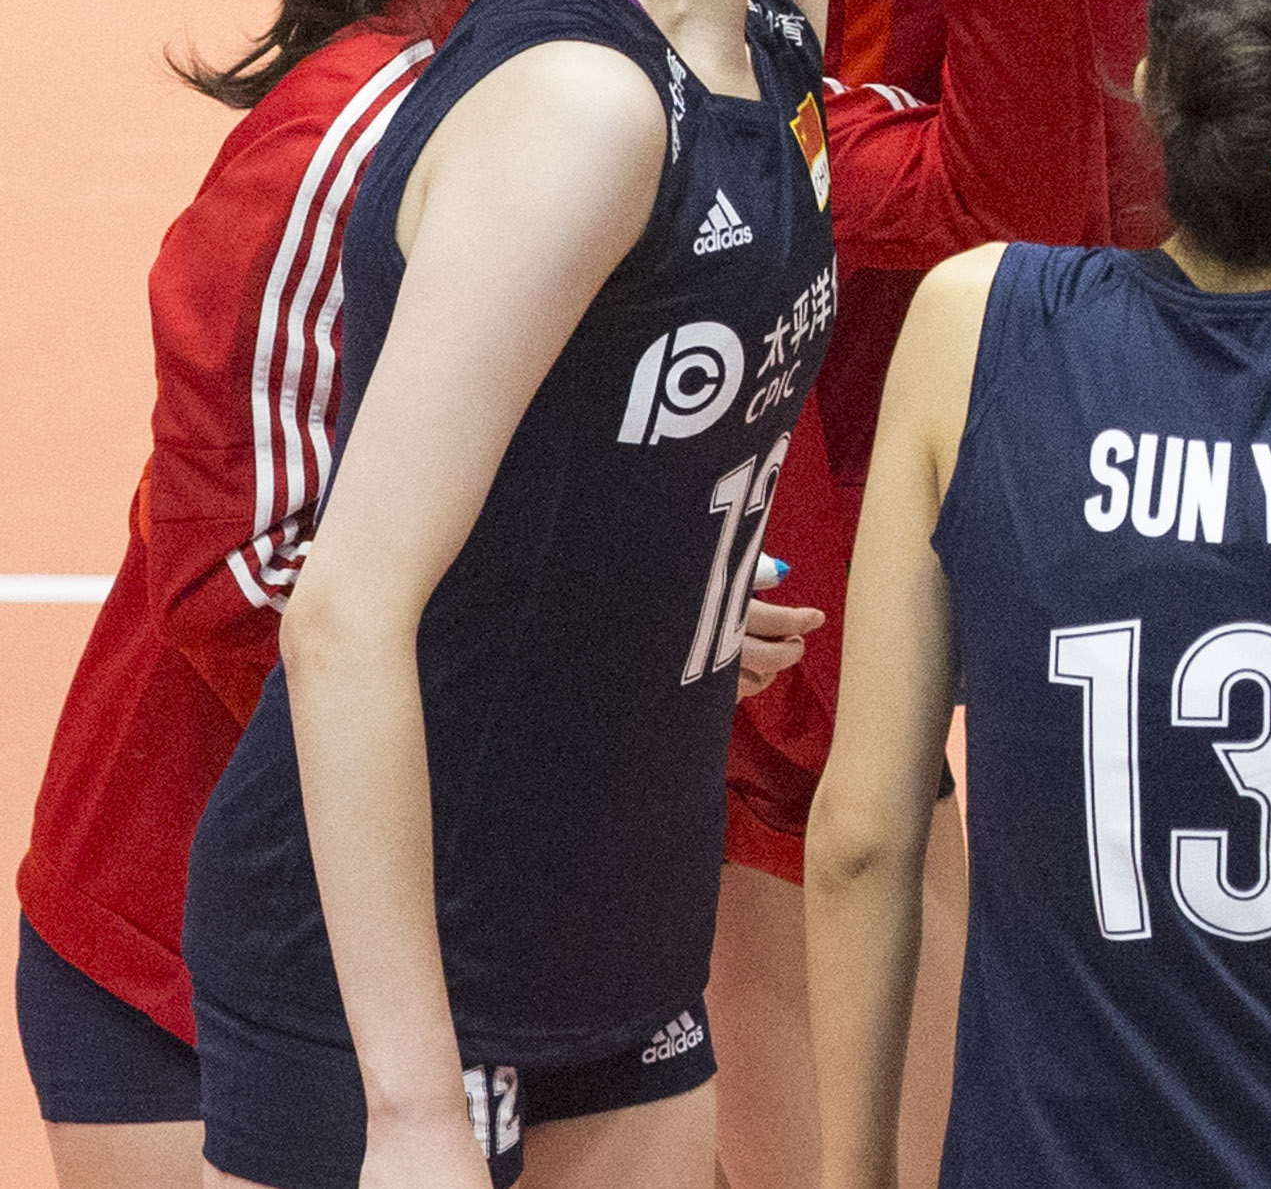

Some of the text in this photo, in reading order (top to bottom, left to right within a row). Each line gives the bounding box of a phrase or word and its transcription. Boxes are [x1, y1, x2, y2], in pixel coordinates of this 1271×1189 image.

[693, 224, 753, 256] adidas
[757, 252, 838, 378] 太平洋
[745, 359, 802, 424] CPIC
[1083, 428, 1233, 544] SUN
[680, 430, 791, 687] 12
[641, 1024, 705, 1065] adidas
